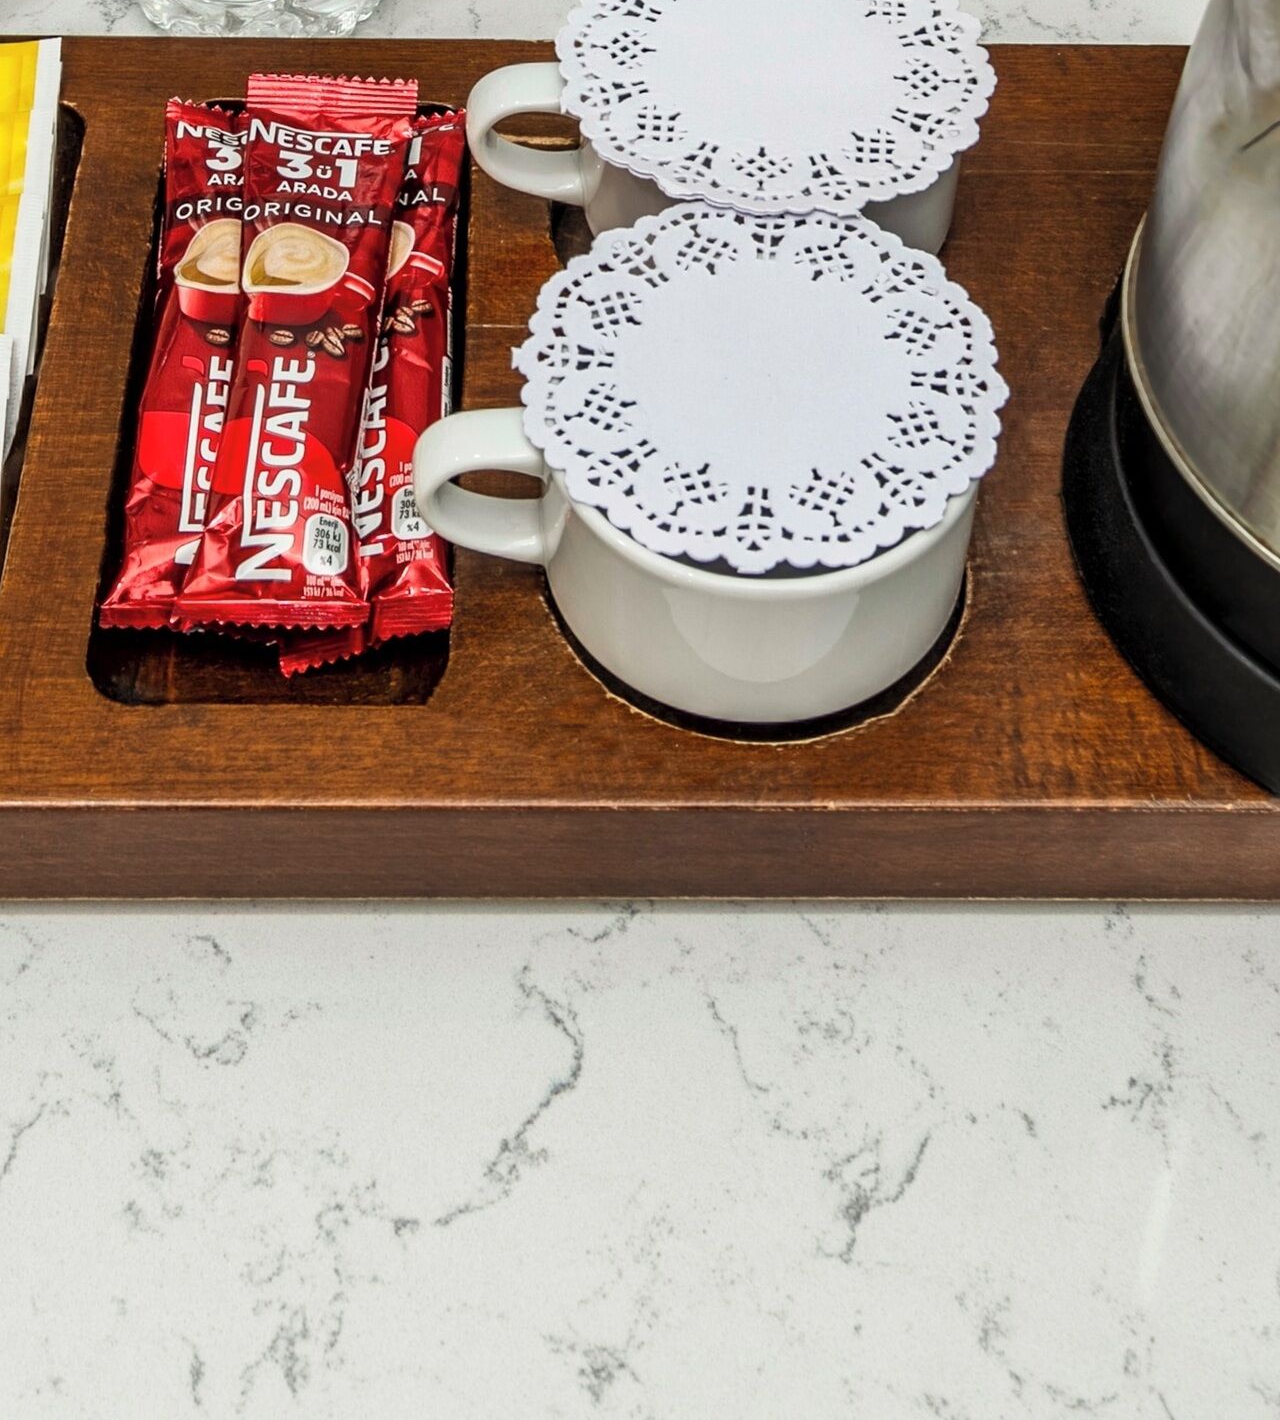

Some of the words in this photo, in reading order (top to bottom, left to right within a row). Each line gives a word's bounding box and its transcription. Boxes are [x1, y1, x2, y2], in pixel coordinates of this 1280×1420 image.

[276, 180, 353, 201] ARADA
[243, 202, 383, 225] ORIGINAL
[400, 499, 416, 510] 306
[399, 510, 410, 520] 73
[314, 527, 331, 540] 306
[332, 531, 342, 542] kJ
[312, 538, 324, 549] 73
